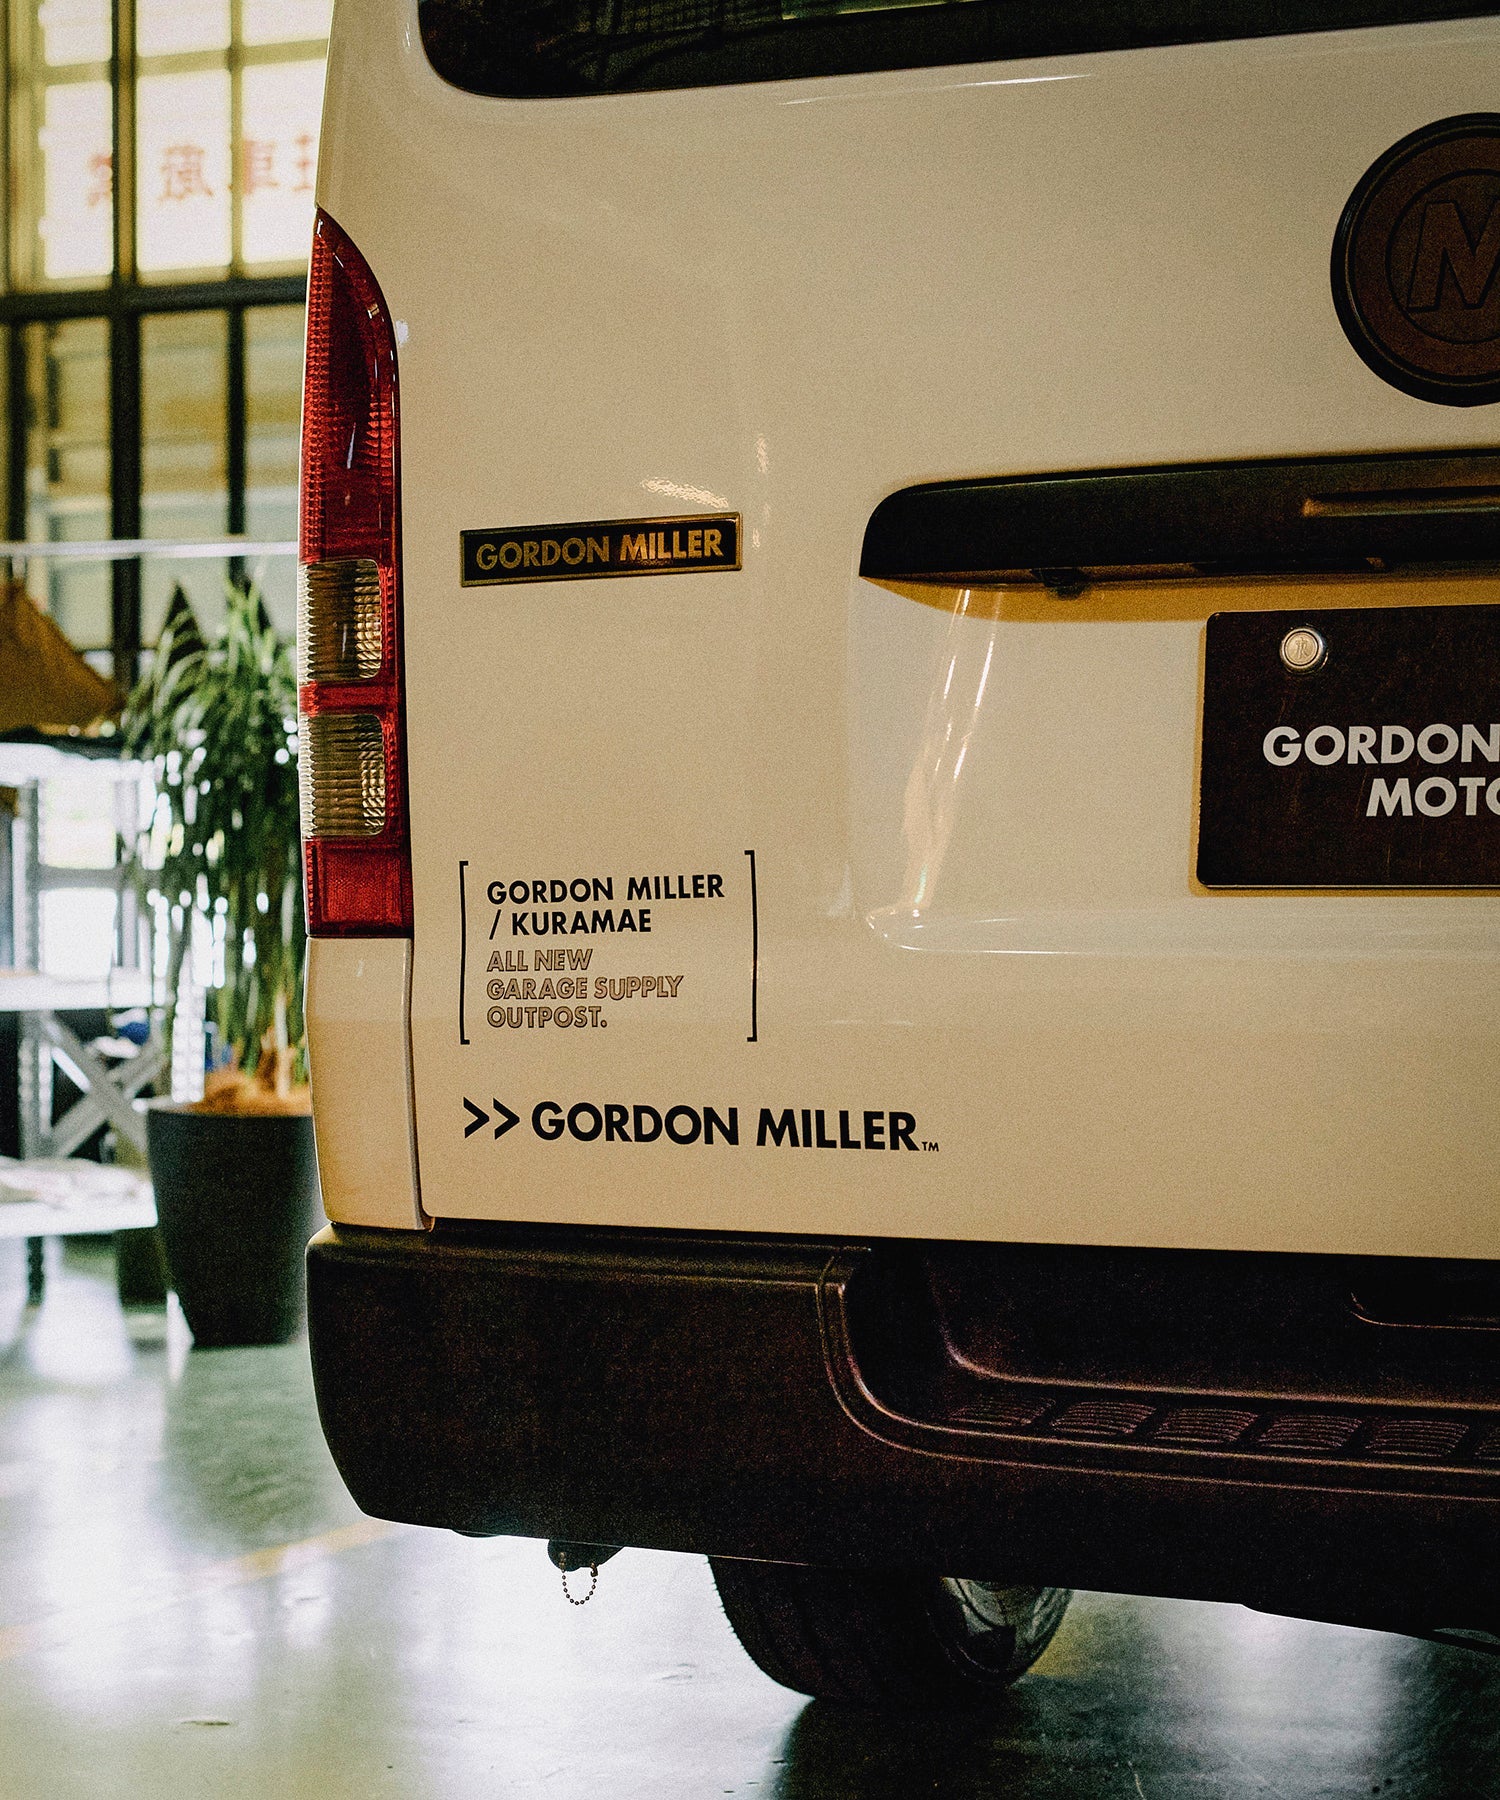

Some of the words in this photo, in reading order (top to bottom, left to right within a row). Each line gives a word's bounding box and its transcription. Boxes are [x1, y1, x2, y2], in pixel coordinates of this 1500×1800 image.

[476, 536, 610, 570] GORDON
[620, 528, 723, 562] MILLER
[1262, 723, 1500, 766] GORDON
[487, 876, 614, 905] GORDON
[627, 873, 725, 901] MILLER
[511, 908, 652, 936] KURAMAE
[486, 950, 529, 972] ALL
[534, 948, 593, 972] NEW
[486, 977, 588, 1001] GARAGE
[594, 975, 685, 1001] SUPPLY
[486, 1005, 608, 1029] OUTPOST.
[531, 1101, 740, 1146] GORDON
[756, 1108, 920, 1152] MILLER
